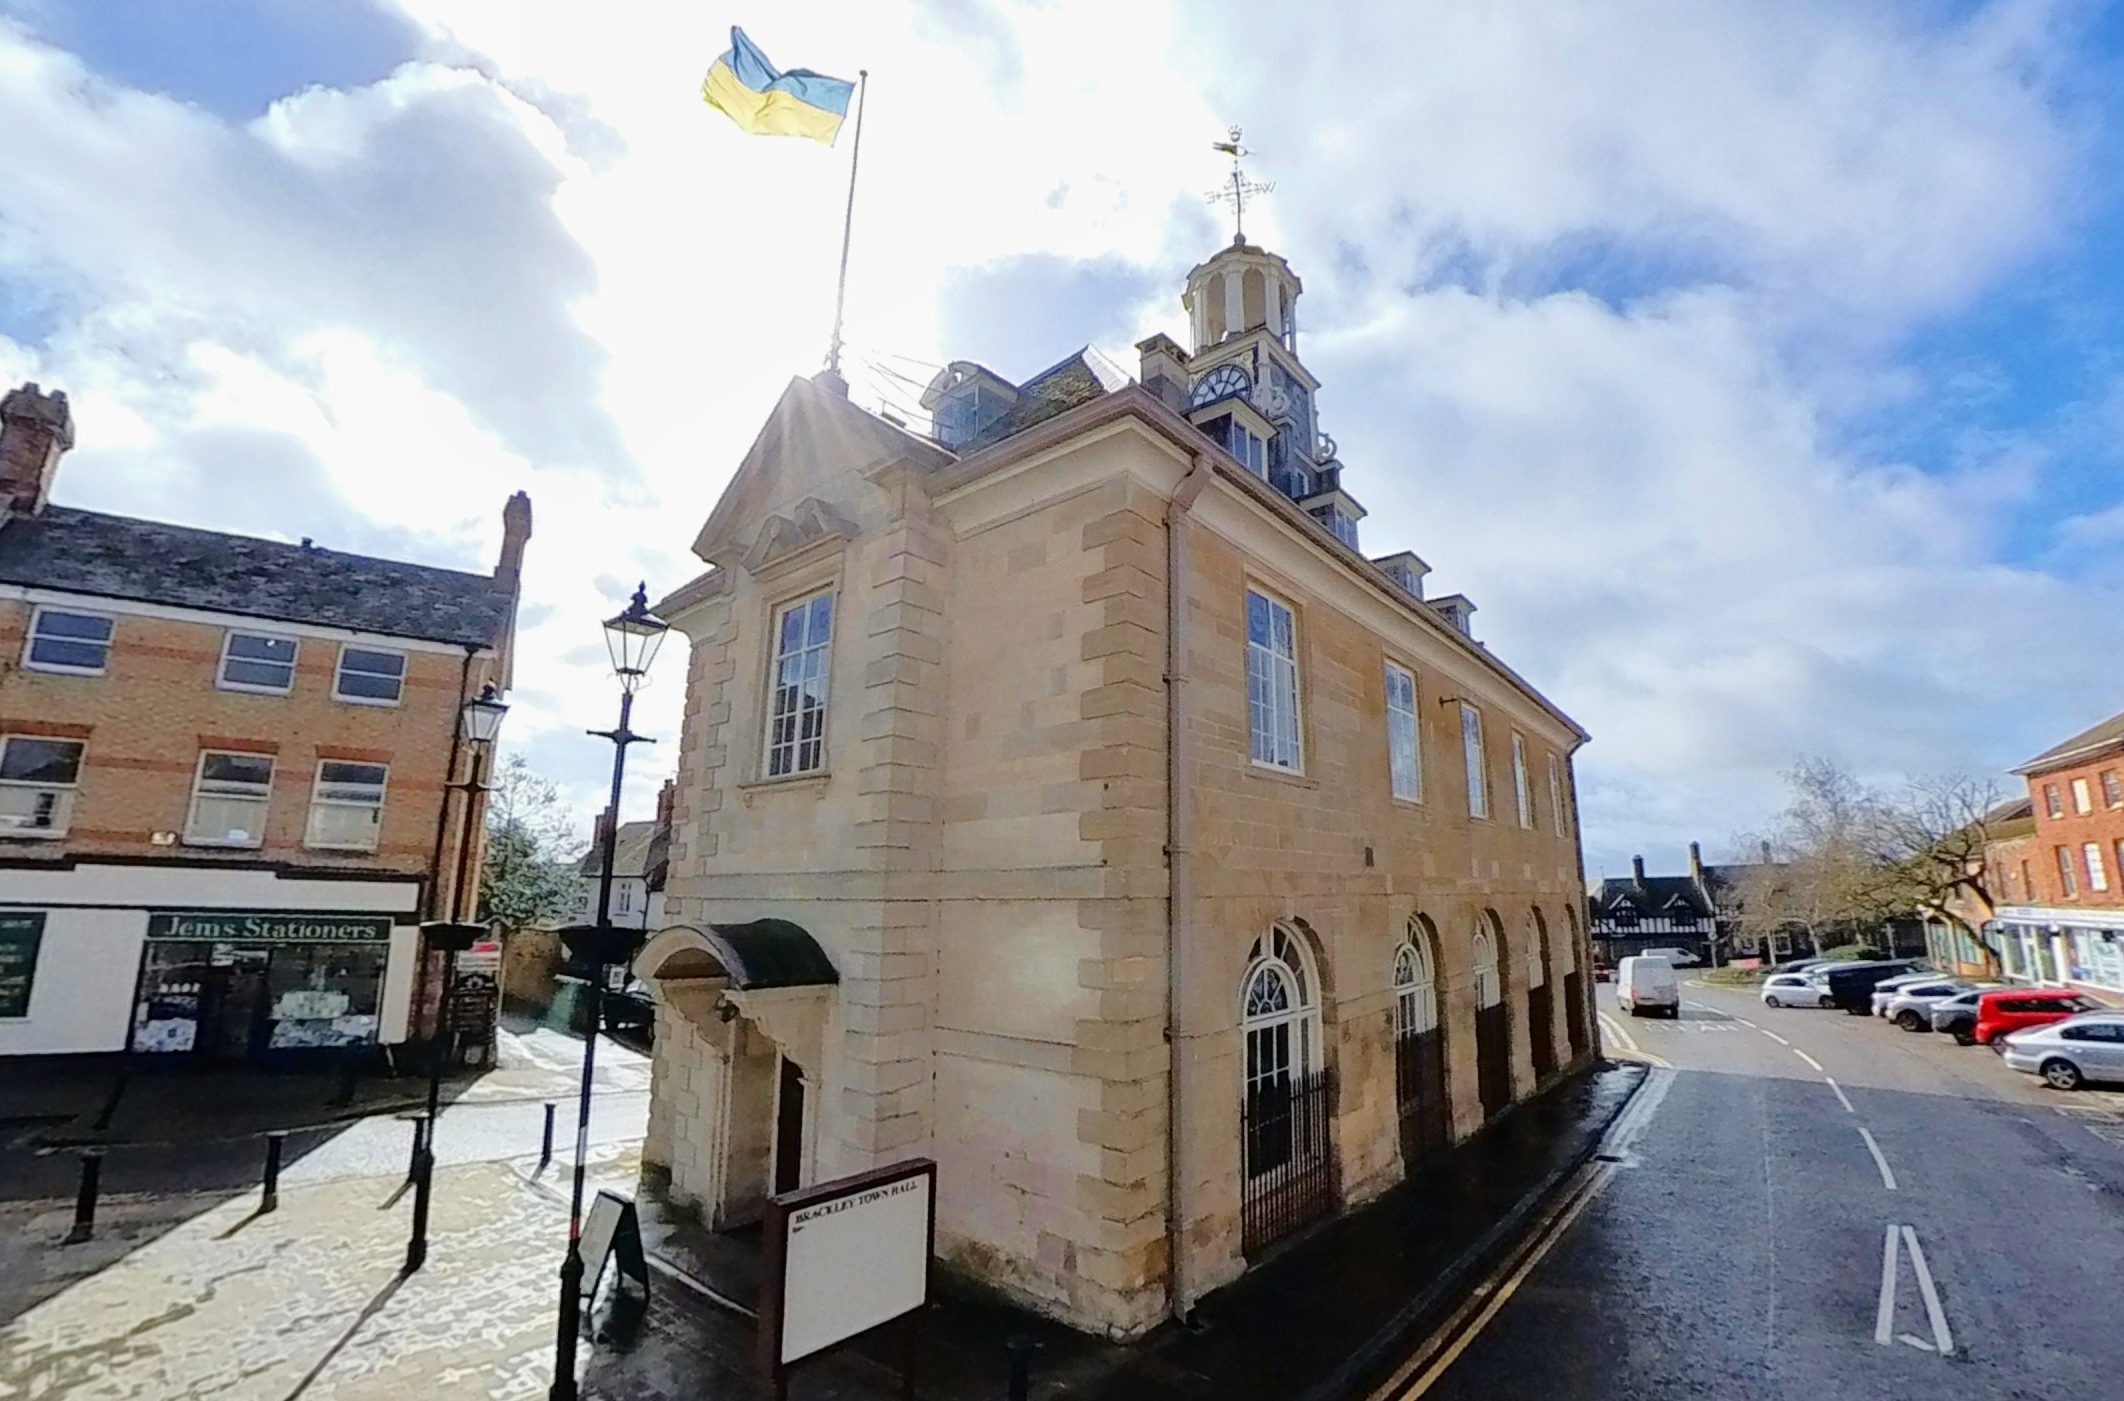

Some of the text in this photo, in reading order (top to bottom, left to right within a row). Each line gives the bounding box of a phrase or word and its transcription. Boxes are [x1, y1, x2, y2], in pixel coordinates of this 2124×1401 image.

[165, 916, 376, 939] Jems Stationers
[796, 1181, 918, 1224] BRACKLEY TOWN HALL
